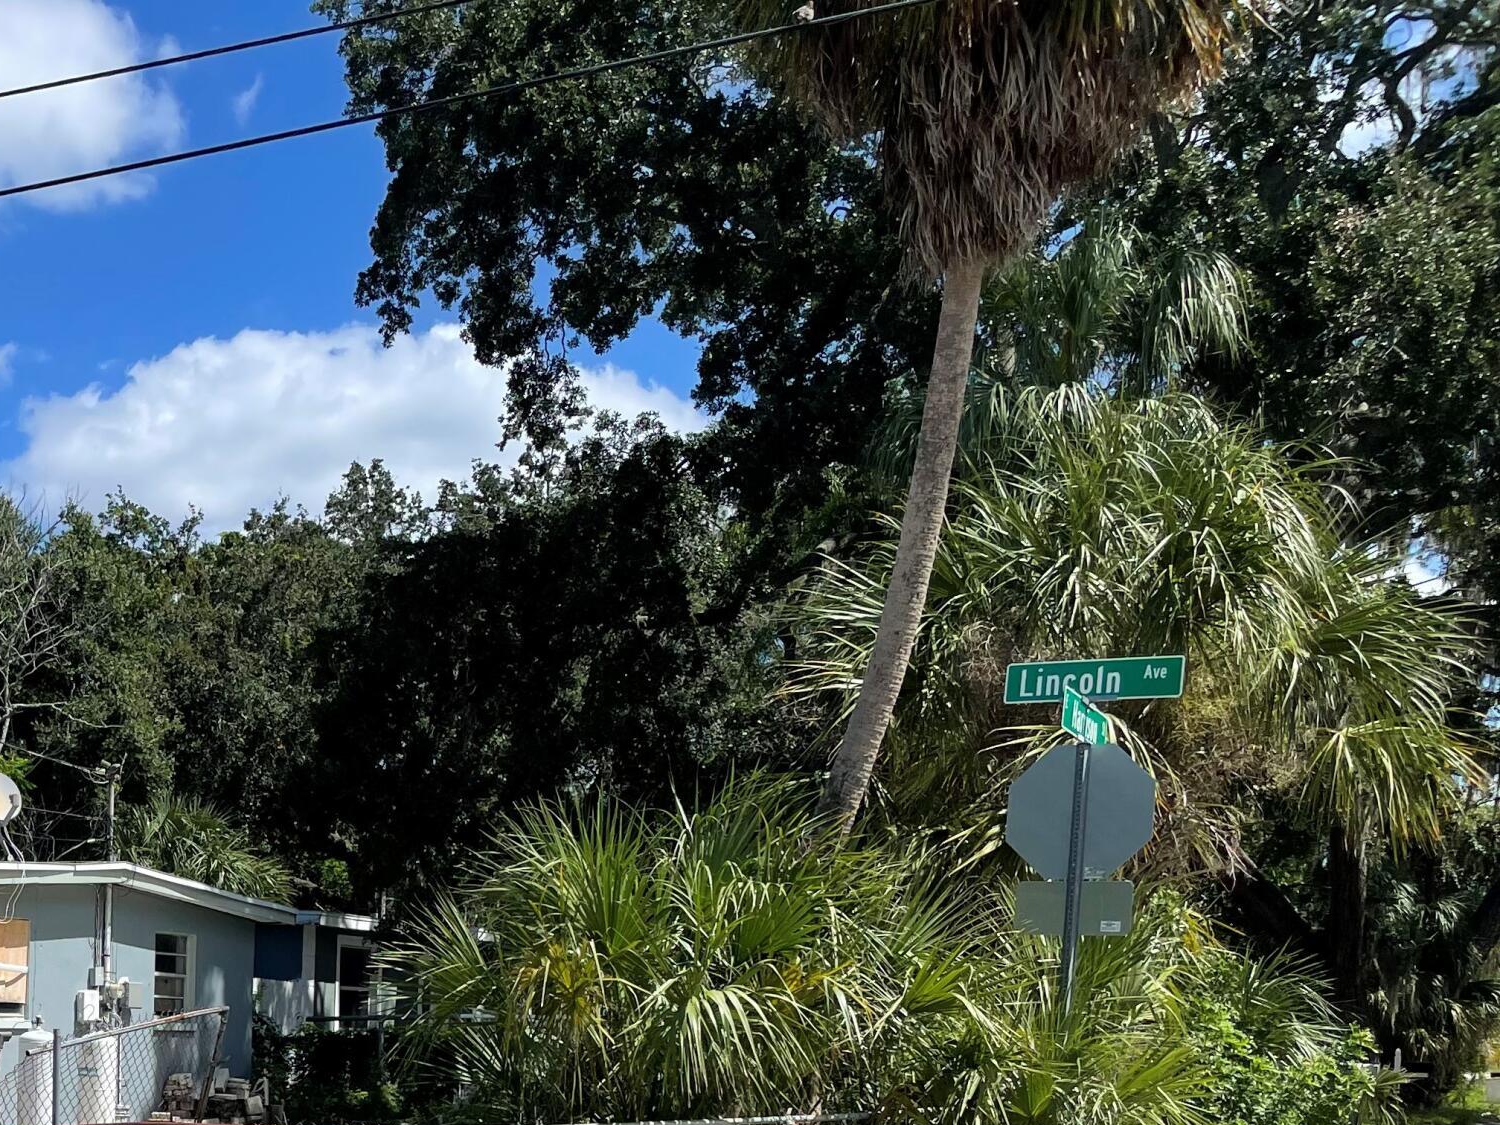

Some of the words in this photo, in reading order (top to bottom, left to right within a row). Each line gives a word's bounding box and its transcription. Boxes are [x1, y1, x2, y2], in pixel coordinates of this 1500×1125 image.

[1019, 665, 1121, 697] Lincoln
[1143, 664, 1168, 680] Ave
[1071, 699, 1098, 745] Harrison
